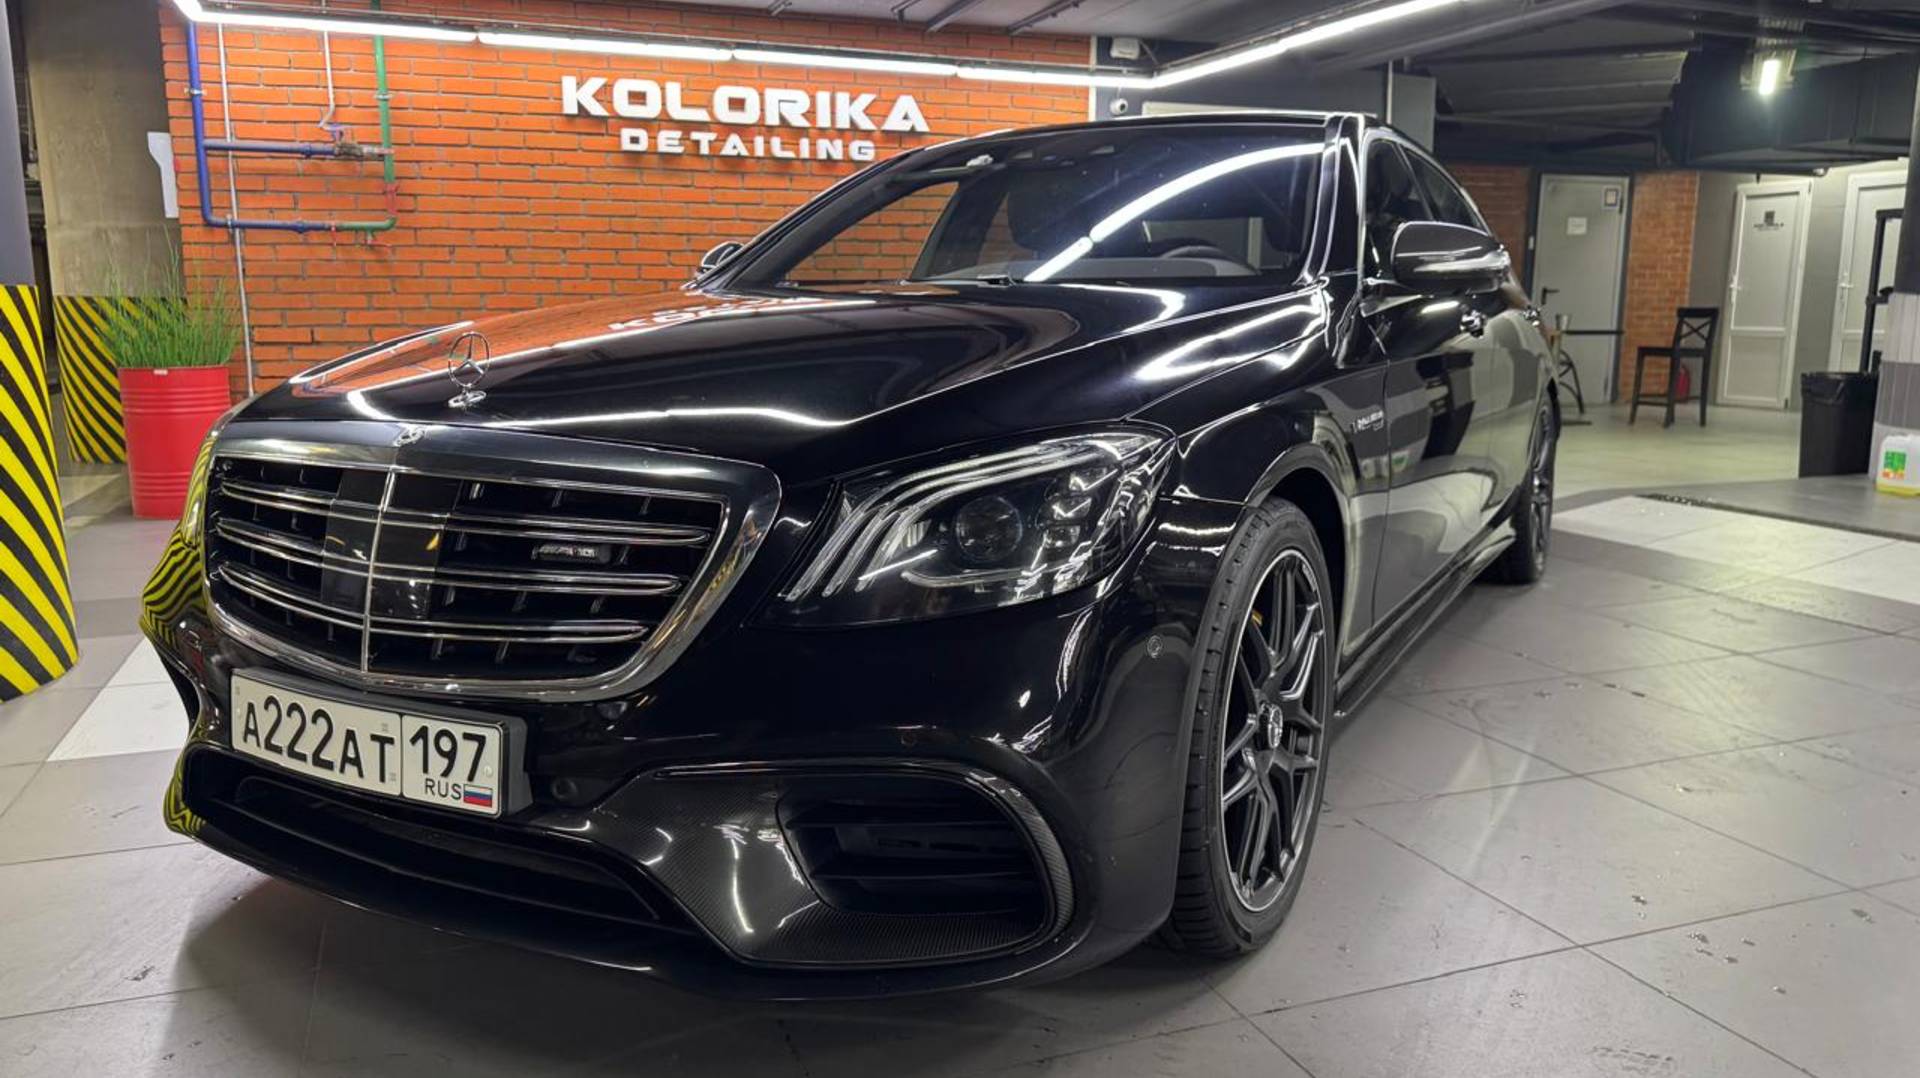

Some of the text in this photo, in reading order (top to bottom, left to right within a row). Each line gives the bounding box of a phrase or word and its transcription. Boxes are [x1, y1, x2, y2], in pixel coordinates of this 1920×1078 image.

[561, 75, 930, 132] KOLORIKA
[620, 128, 875, 161] DETAILING
[409, 725, 486, 782] 197
[425, 778, 462, 801] RUS
